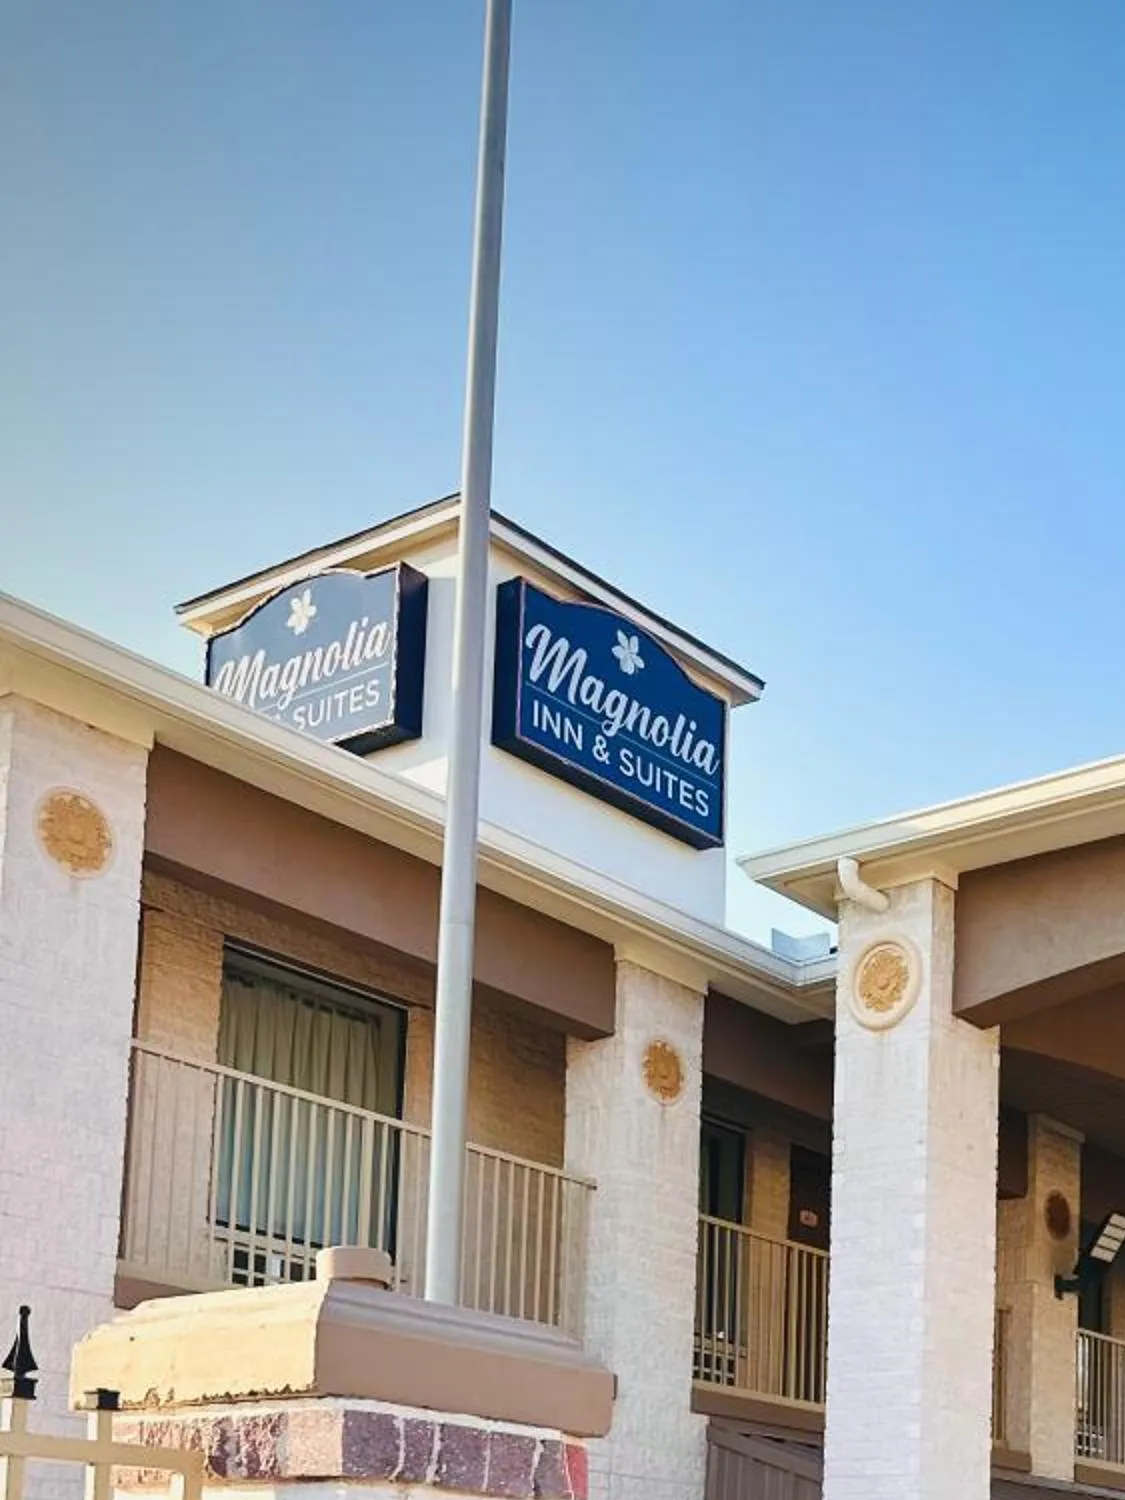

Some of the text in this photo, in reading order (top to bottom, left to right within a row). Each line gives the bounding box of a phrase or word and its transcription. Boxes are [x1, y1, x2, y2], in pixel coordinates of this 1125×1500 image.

[213, 617, 392, 709] Magnolia
[293, 680, 380, 731] SUITES
[525, 624, 720, 775] Magnolia
[533, 700, 709, 816] INN & SUITES
